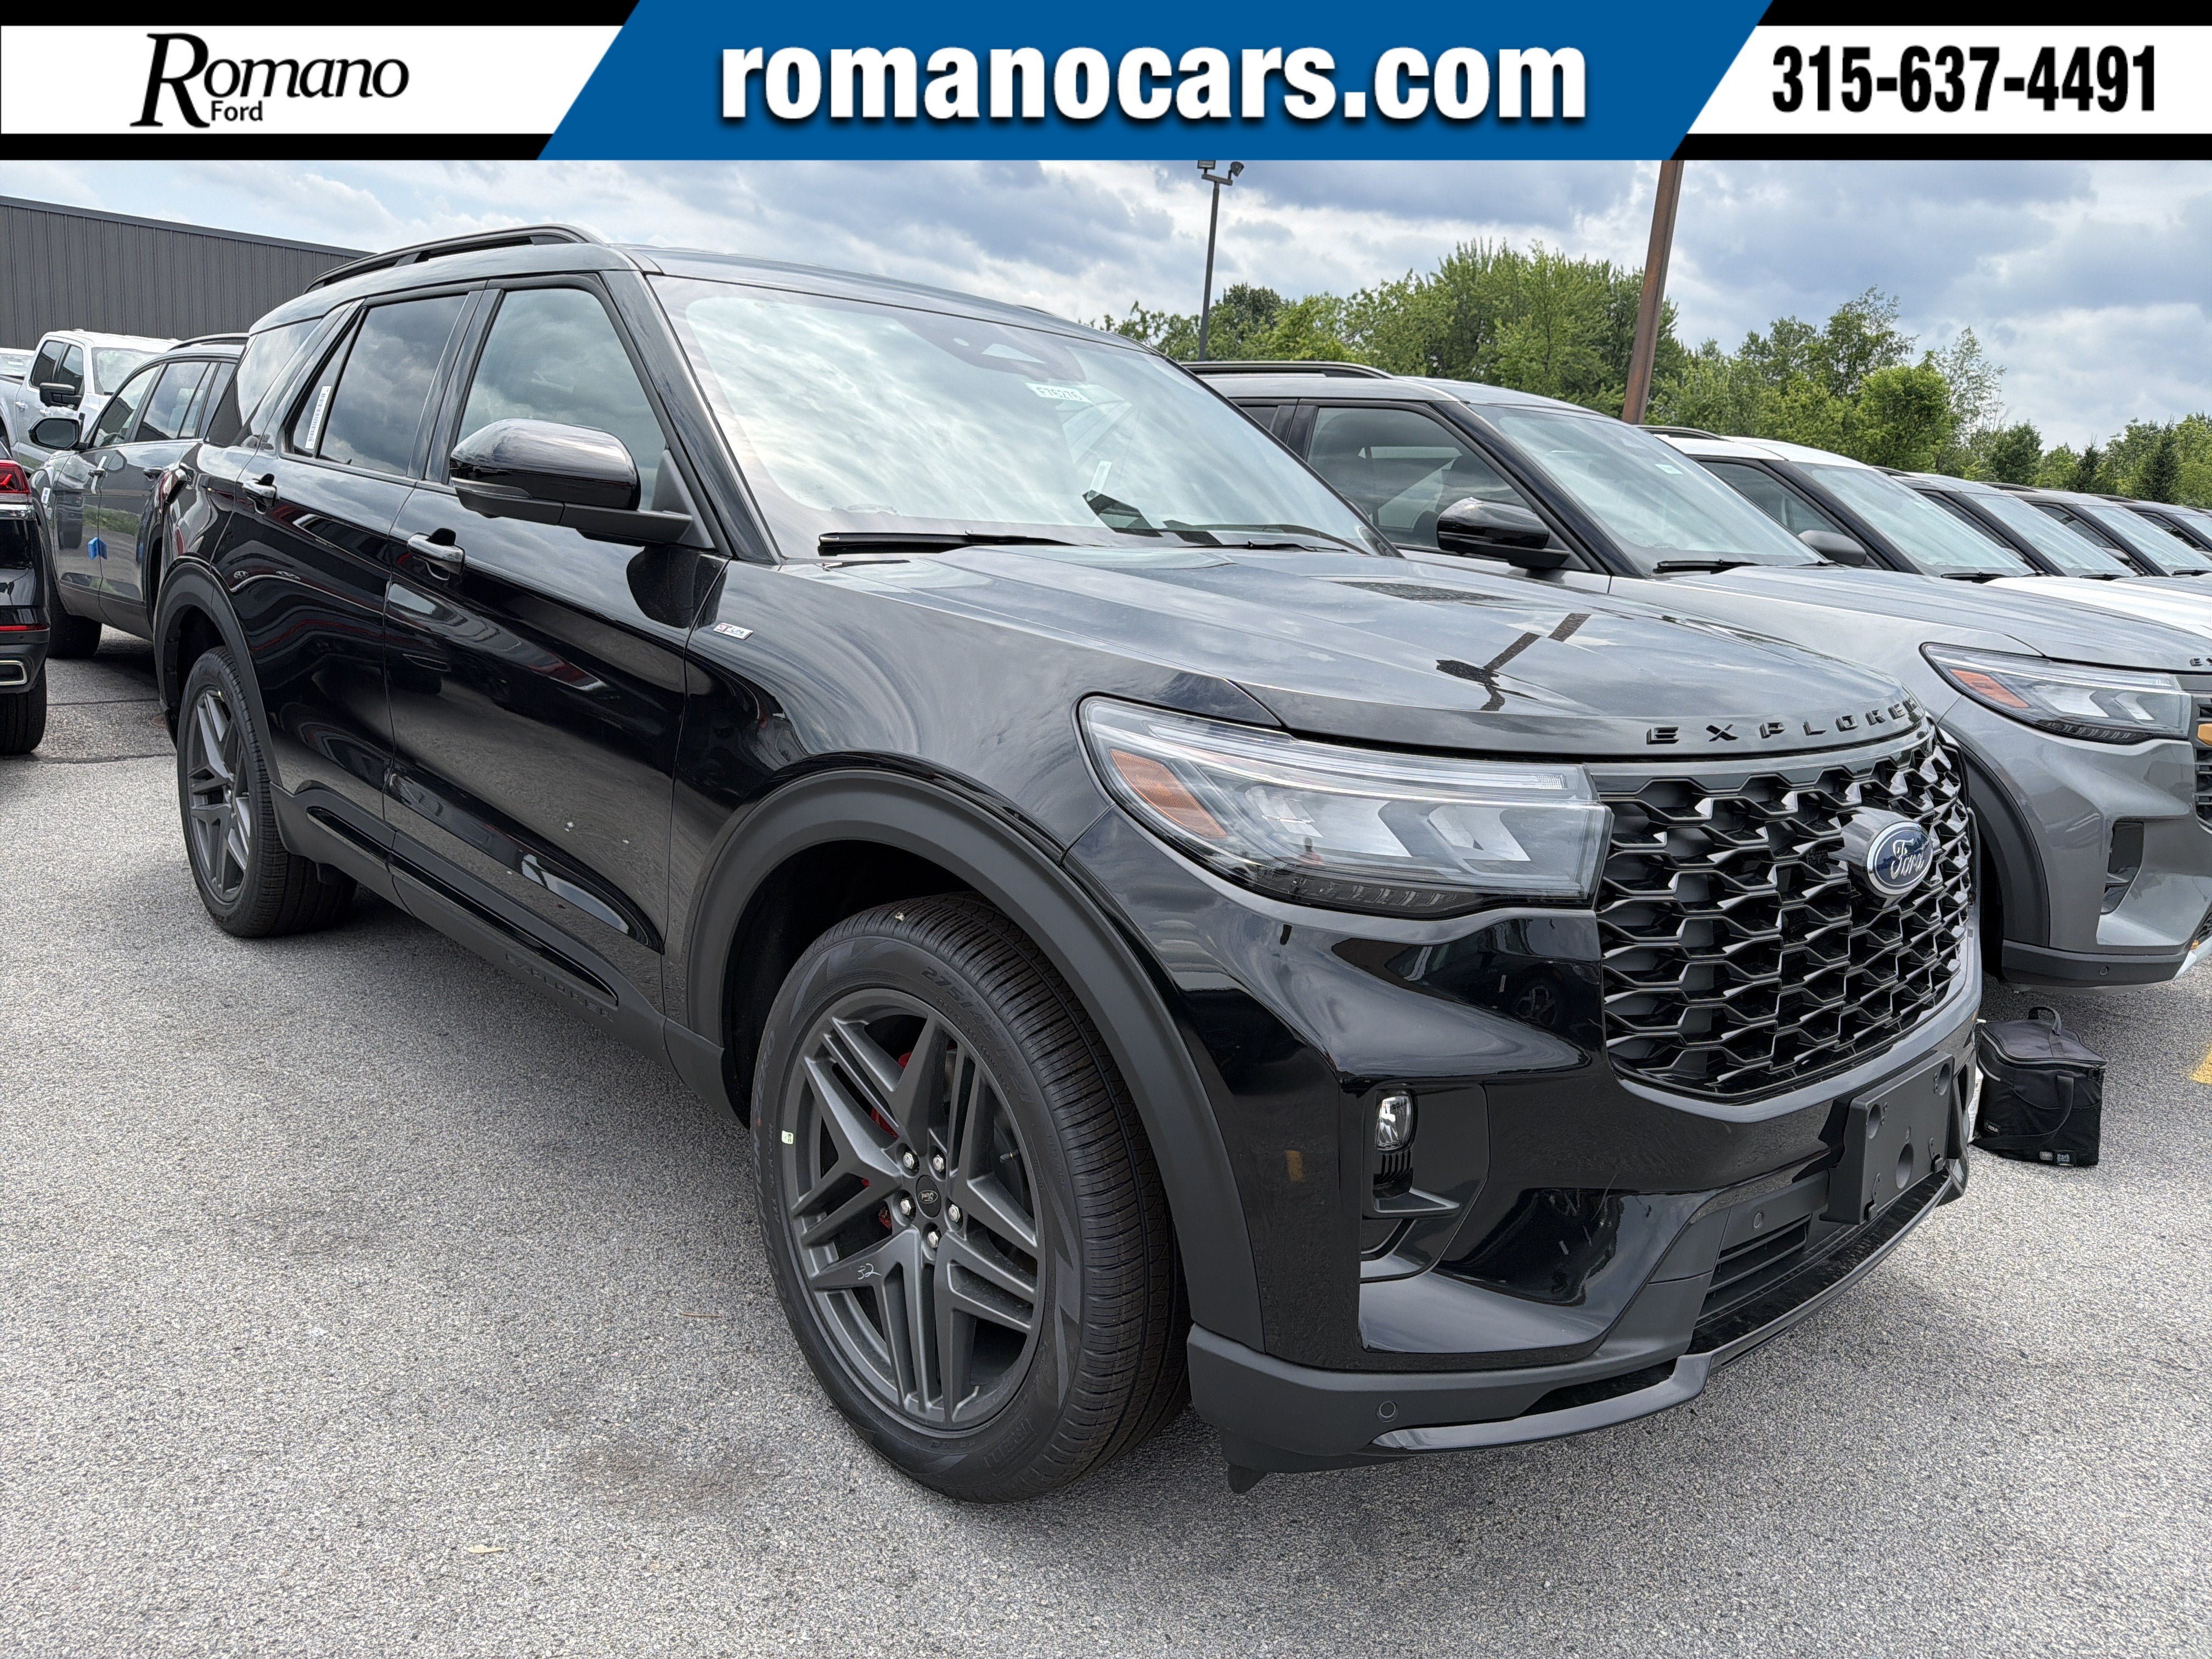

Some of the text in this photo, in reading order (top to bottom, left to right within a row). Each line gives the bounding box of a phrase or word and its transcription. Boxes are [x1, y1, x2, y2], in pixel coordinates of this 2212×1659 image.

[716, 623, 733, 633] ST
[1646, 697, 1918, 744] EXPLORER
[1891, 838, 1927, 879] Ford
[921, 966, 998, 1041] 275/45
[921, 1192, 934, 1202] Ford
[857, 1262, 882, 1280] 32
